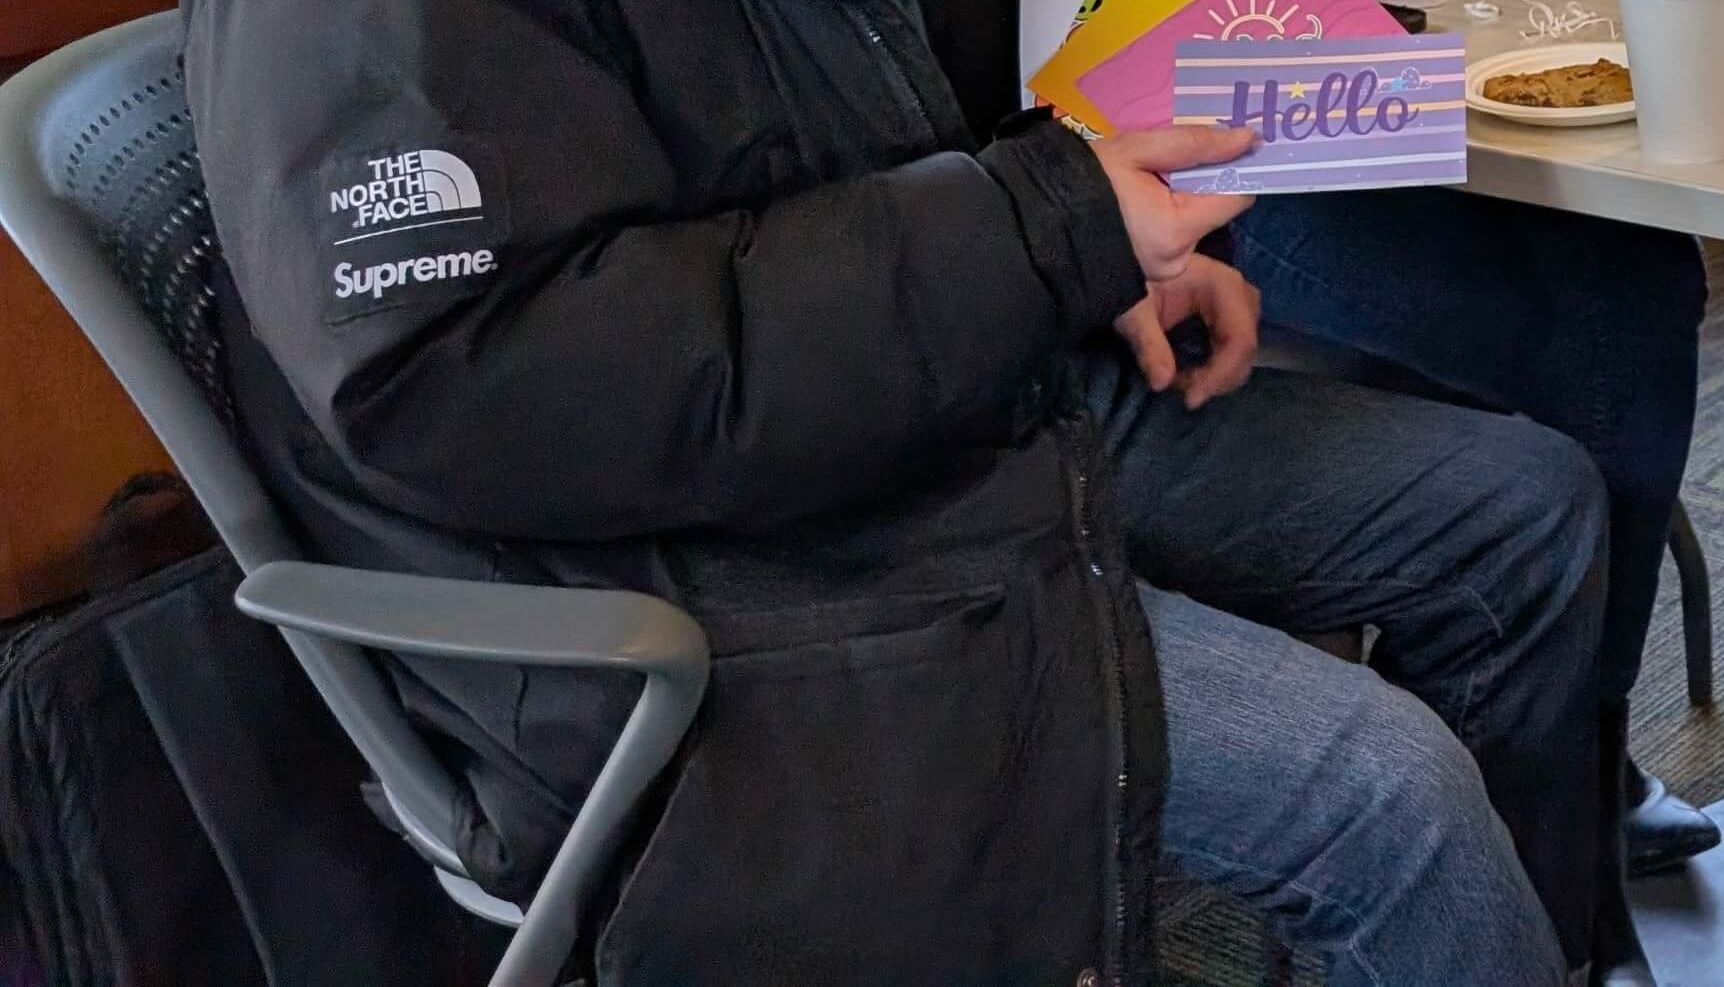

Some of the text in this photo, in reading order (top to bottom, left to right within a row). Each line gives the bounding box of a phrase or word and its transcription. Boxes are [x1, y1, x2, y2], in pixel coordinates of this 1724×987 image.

[1216, 68, 1420, 144] Hello
[368, 151, 420, 180] THE
[330, 172, 425, 213] NORTH
[357, 193, 429, 227] FACE
[333, 248, 495, 299] Supreme
